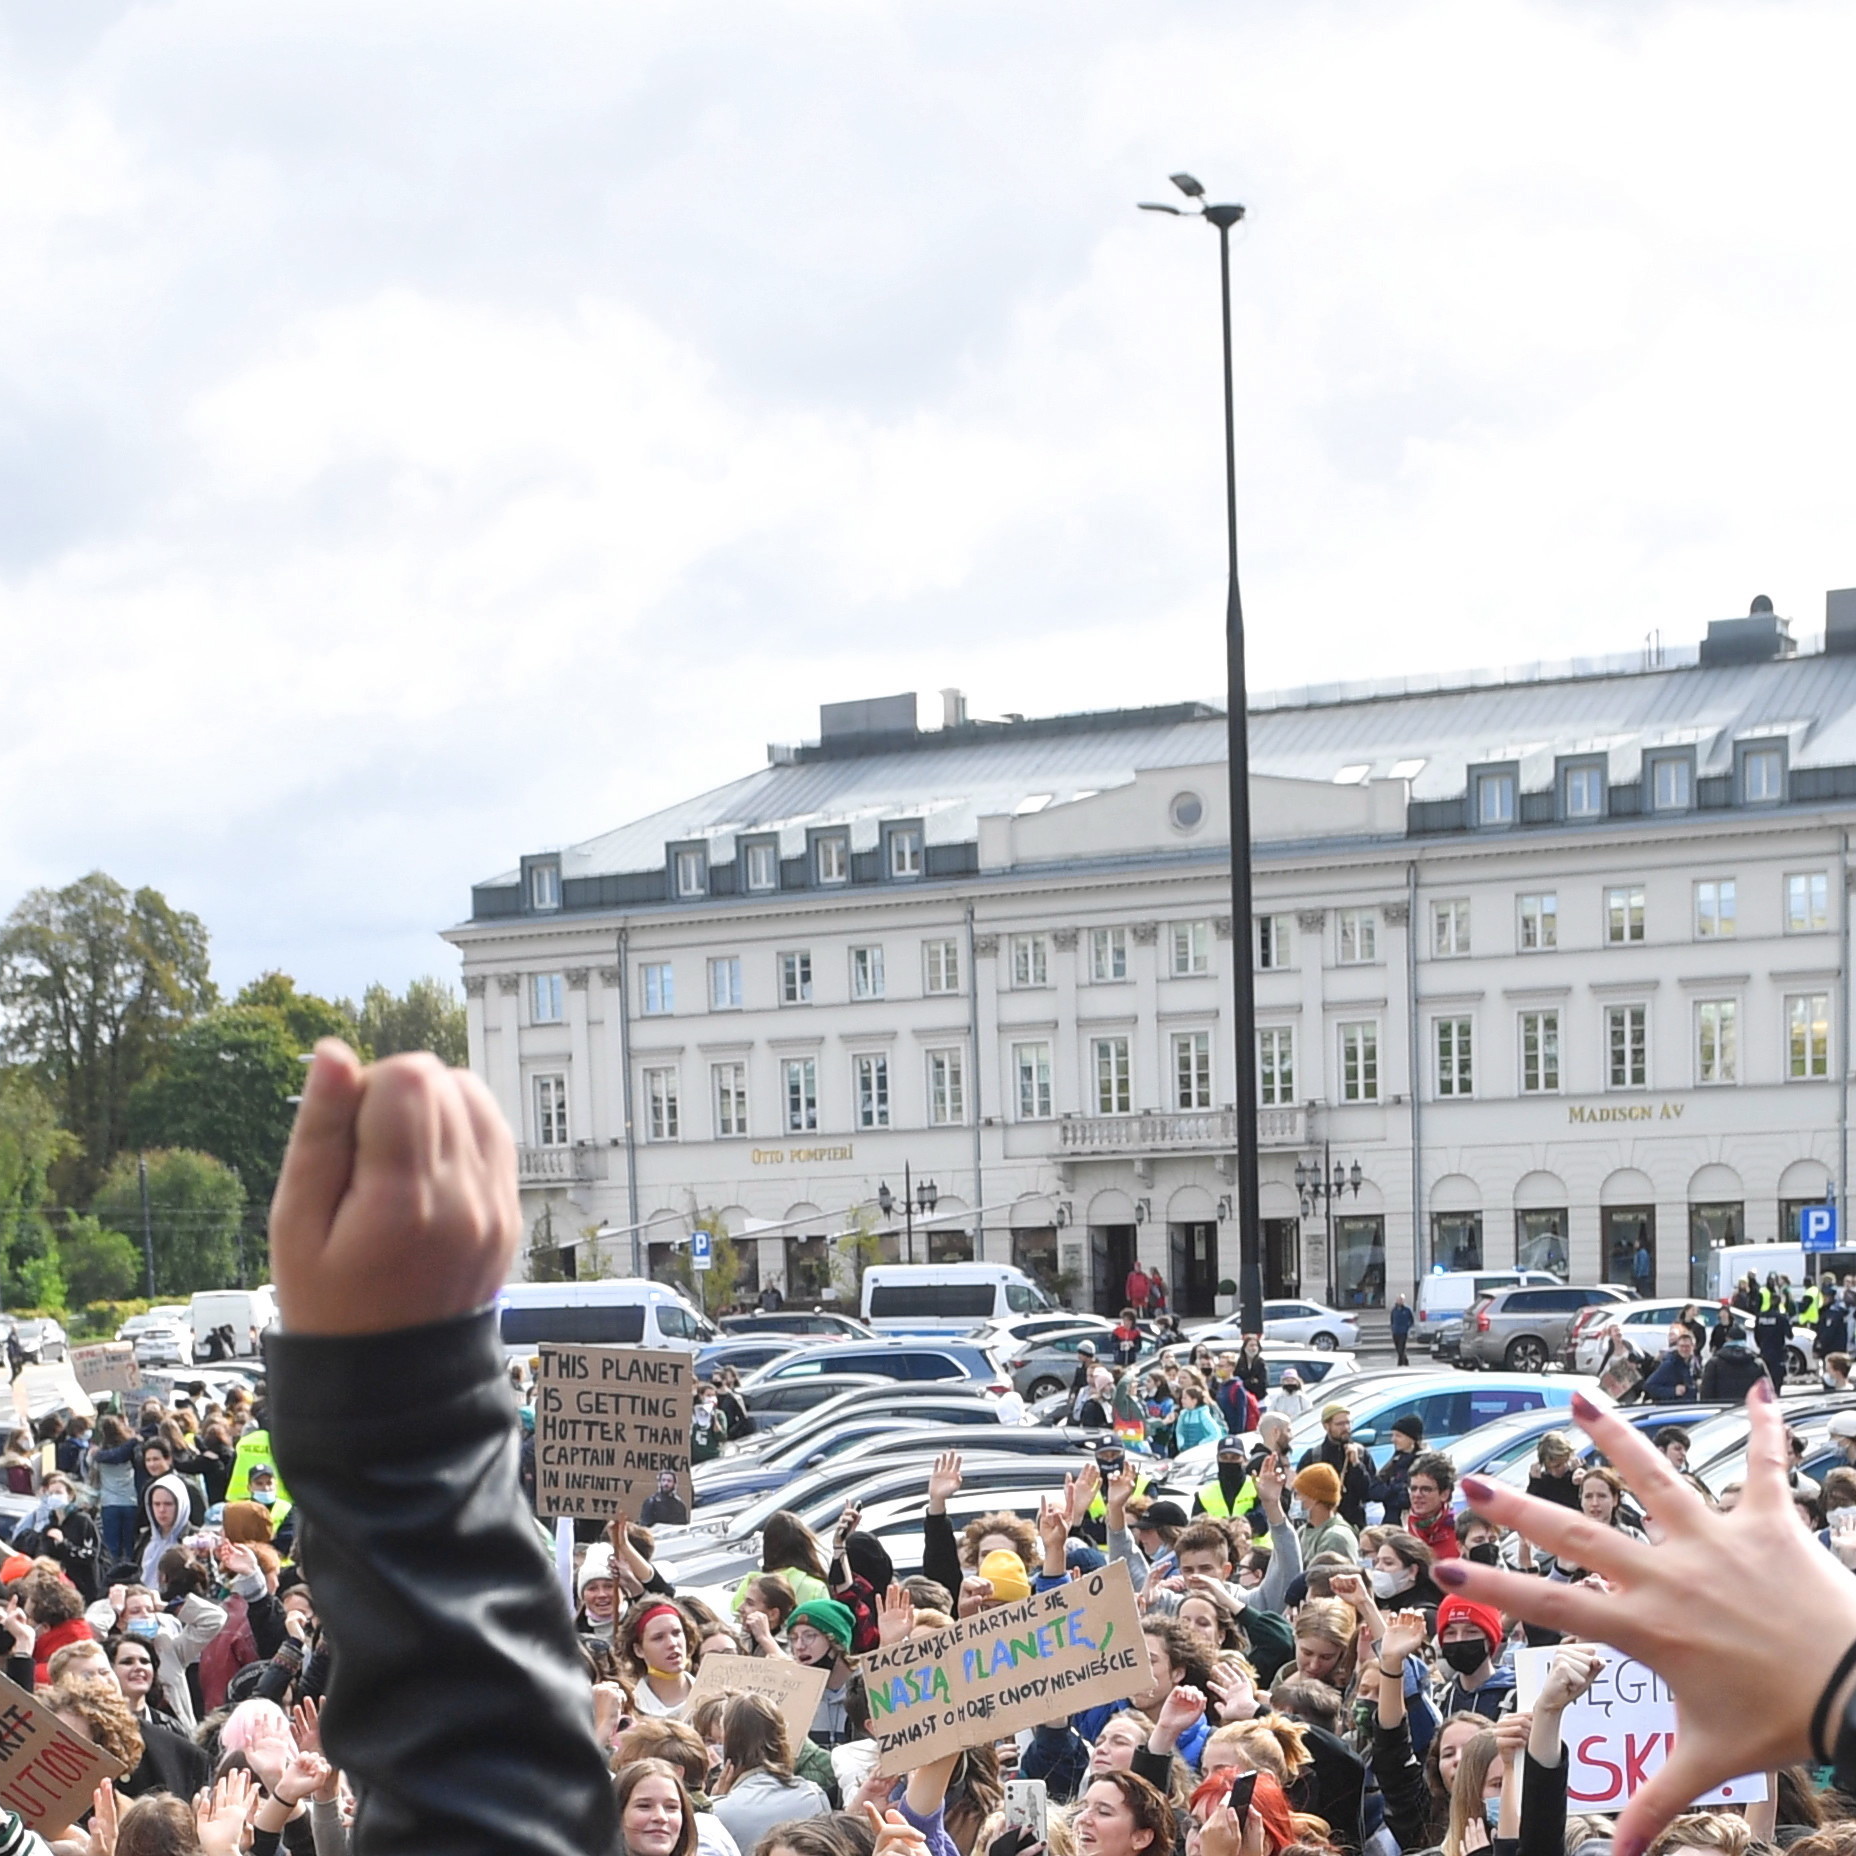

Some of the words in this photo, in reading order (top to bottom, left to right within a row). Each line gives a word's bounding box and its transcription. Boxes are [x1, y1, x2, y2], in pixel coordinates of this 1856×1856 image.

[1569, 1106, 1652, 1123] MADISON
[1660, 1102, 1684, 1120] AV
[752, 1148, 783, 1164] OTTO
[790, 1144, 853, 1162] POMPIERI
[1809, 1211, 1830, 1239] P
[696, 1234, 707, 1254] P
[539, 1350, 589, 1379] THIS
[602, 1358, 684, 1386] PLANET
[544, 1386, 563, 1413] IS
[576, 1391, 678, 1418] GETTING
[543, 1415, 626, 1443] HOTTER
[633, 1424, 683, 1445] THAN
[542, 1445, 615, 1466] CAPTAIN
[623, 1450, 690, 1473] AMERICA
[543, 1470, 559, 1488] IN
[565, 1472, 633, 1494] INFINITY
[546, 1495, 585, 1513] WAR
[867, 1625, 964, 1672] ZACZNIJCIE
[969, 1597, 1039, 1638] MARTWIĆ
[1044, 1591, 1068, 1611] SIĘ
[1089, 1575, 1103, 1596] O
[869, 1665, 951, 1719] NASZĄ
[879, 1715, 937, 1751] ZAMIAST
[944, 1710, 954, 1725] O
[999, 1676, 1048, 1706] CNOTY
[1051, 1648, 1137, 1691] NIEWIEŚCIE
